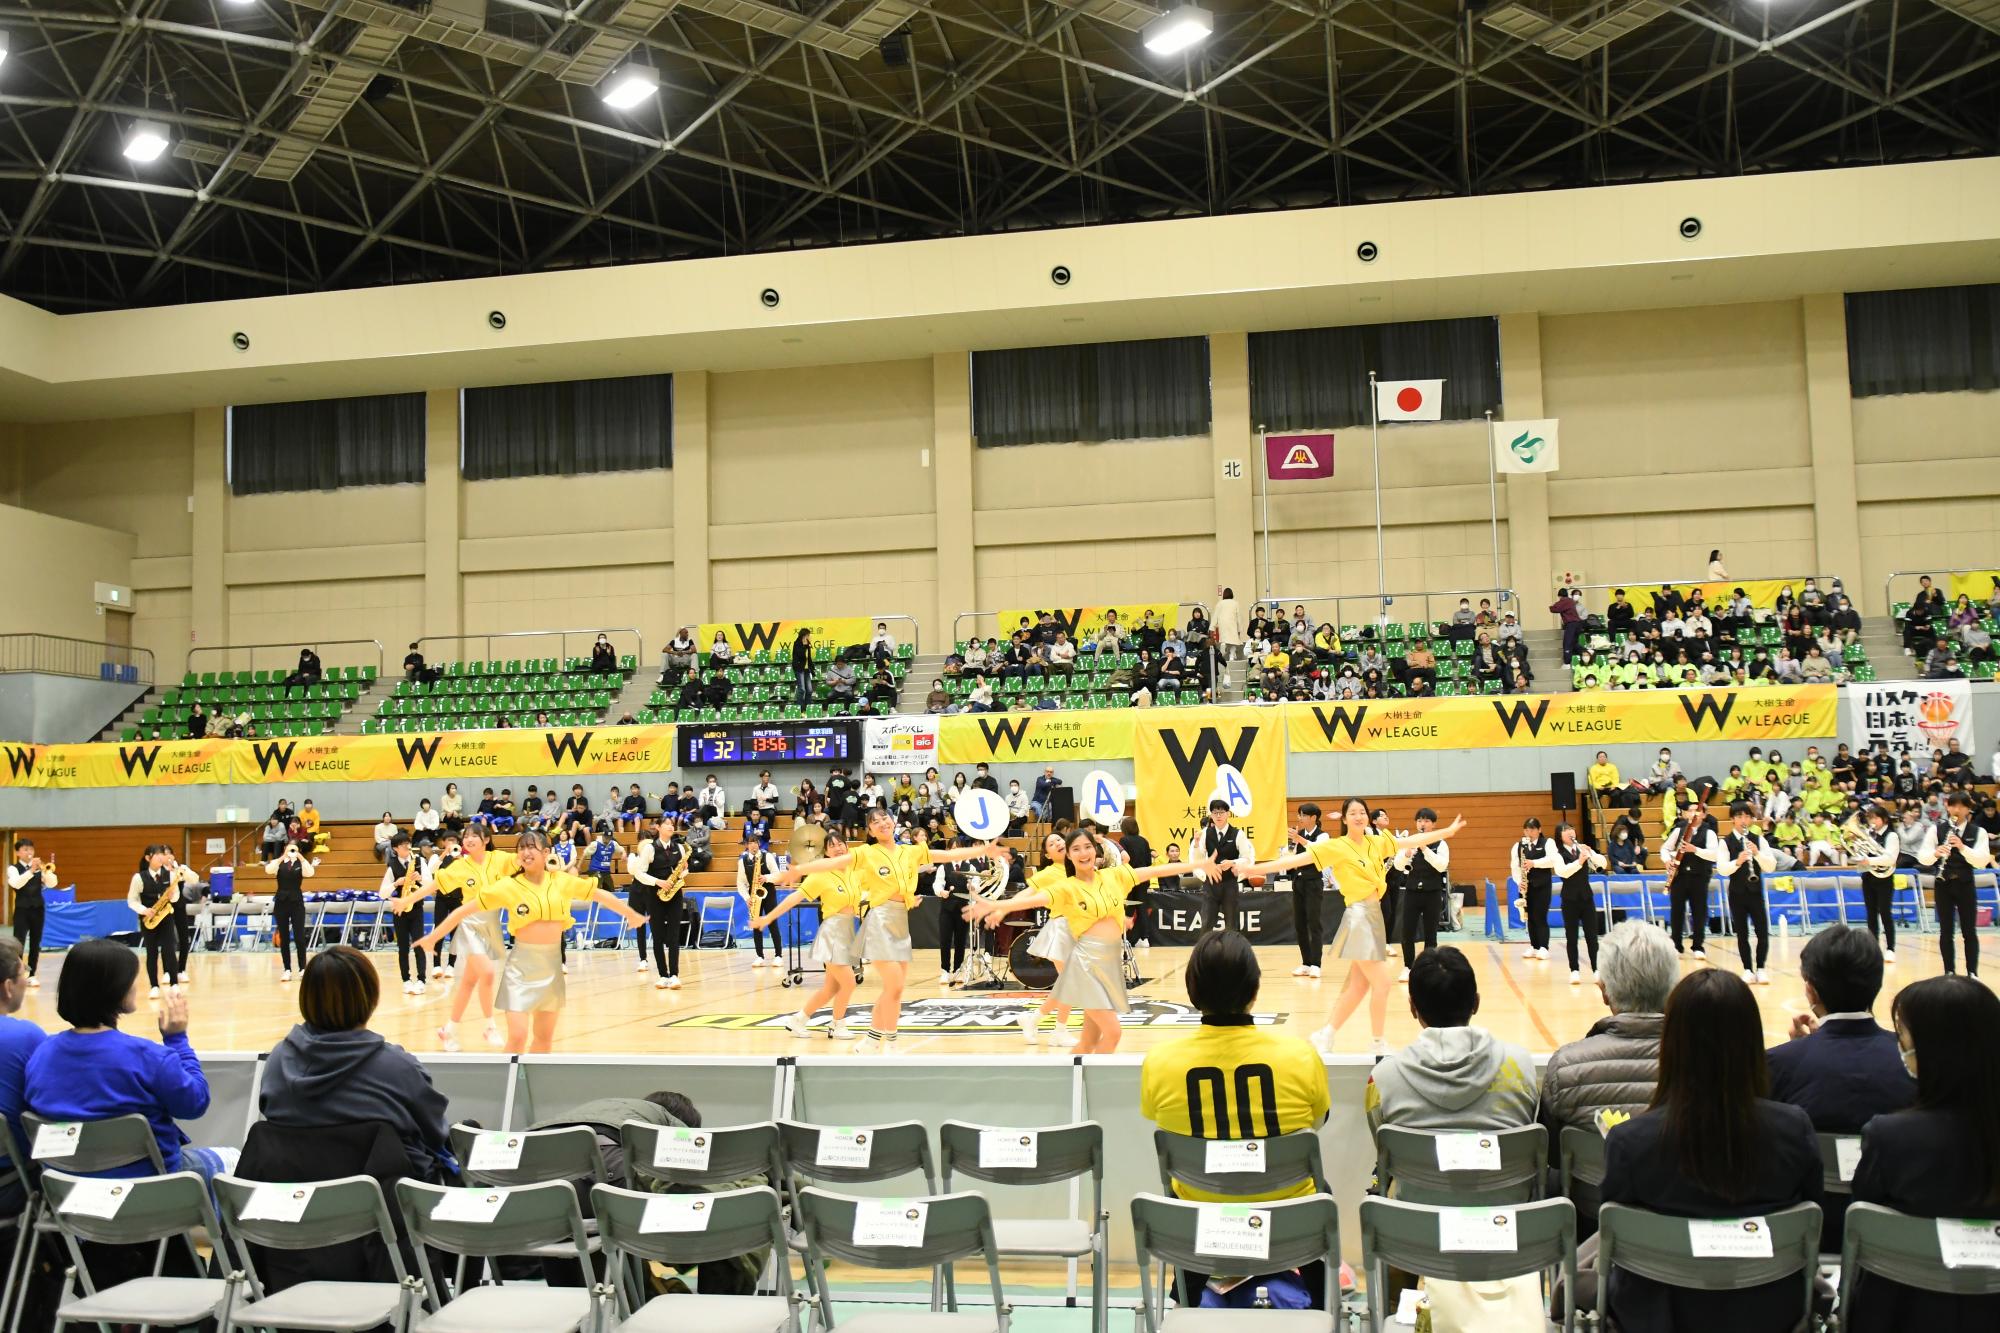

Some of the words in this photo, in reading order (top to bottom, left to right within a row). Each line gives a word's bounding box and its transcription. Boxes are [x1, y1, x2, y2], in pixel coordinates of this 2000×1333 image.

[1224, 461, 1241, 478] 北
[735, 622, 780, 651] W
[1492, 700, 1550, 739] W
[1678, 693, 1738, 733] W
[1736, 715, 1752, 726] W
[1755, 712, 1810, 727] LEAGUE
[882, 724, 924, 734] スポーツくじ
[1312, 706, 1368, 744] W
[1367, 727, 1383, 738] W
[1385, 725, 1438, 739] LEAGUE
[1549, 721, 1565, 732] W
[1568, 719, 1622, 733] LEAGUE
[753, 738, 787, 751] 13:56
[978, 717, 1031, 756] W
[1029, 738, 1043, 748] W
[1046, 736, 1095, 750] LEAGUE
[396, 736, 443, 772] W
[546, 732, 594, 767] W
[590, 752, 603, 762] W
[605, 750, 651, 763] LEAGUE
[713, 740, 734, 759] 32
[805, 737, 827, 757] 32
[120, 746, 162, 778] W
[158, 764, 170, 773] W
[172, 762, 212, 775] LEAGUE
[253, 741, 298, 776] W
[294, 761, 306, 770] W
[308, 759, 350, 771] LEAGUE
[439, 756, 452, 766] W
[454, 755, 498, 767] LEAGUE
[1158, 727, 1259, 797] W
[1094, 779, 1119, 814] A
[1227, 773, 1249, 806] A
[970, 797, 990, 829] J
[1169, 828, 1187, 839] W
